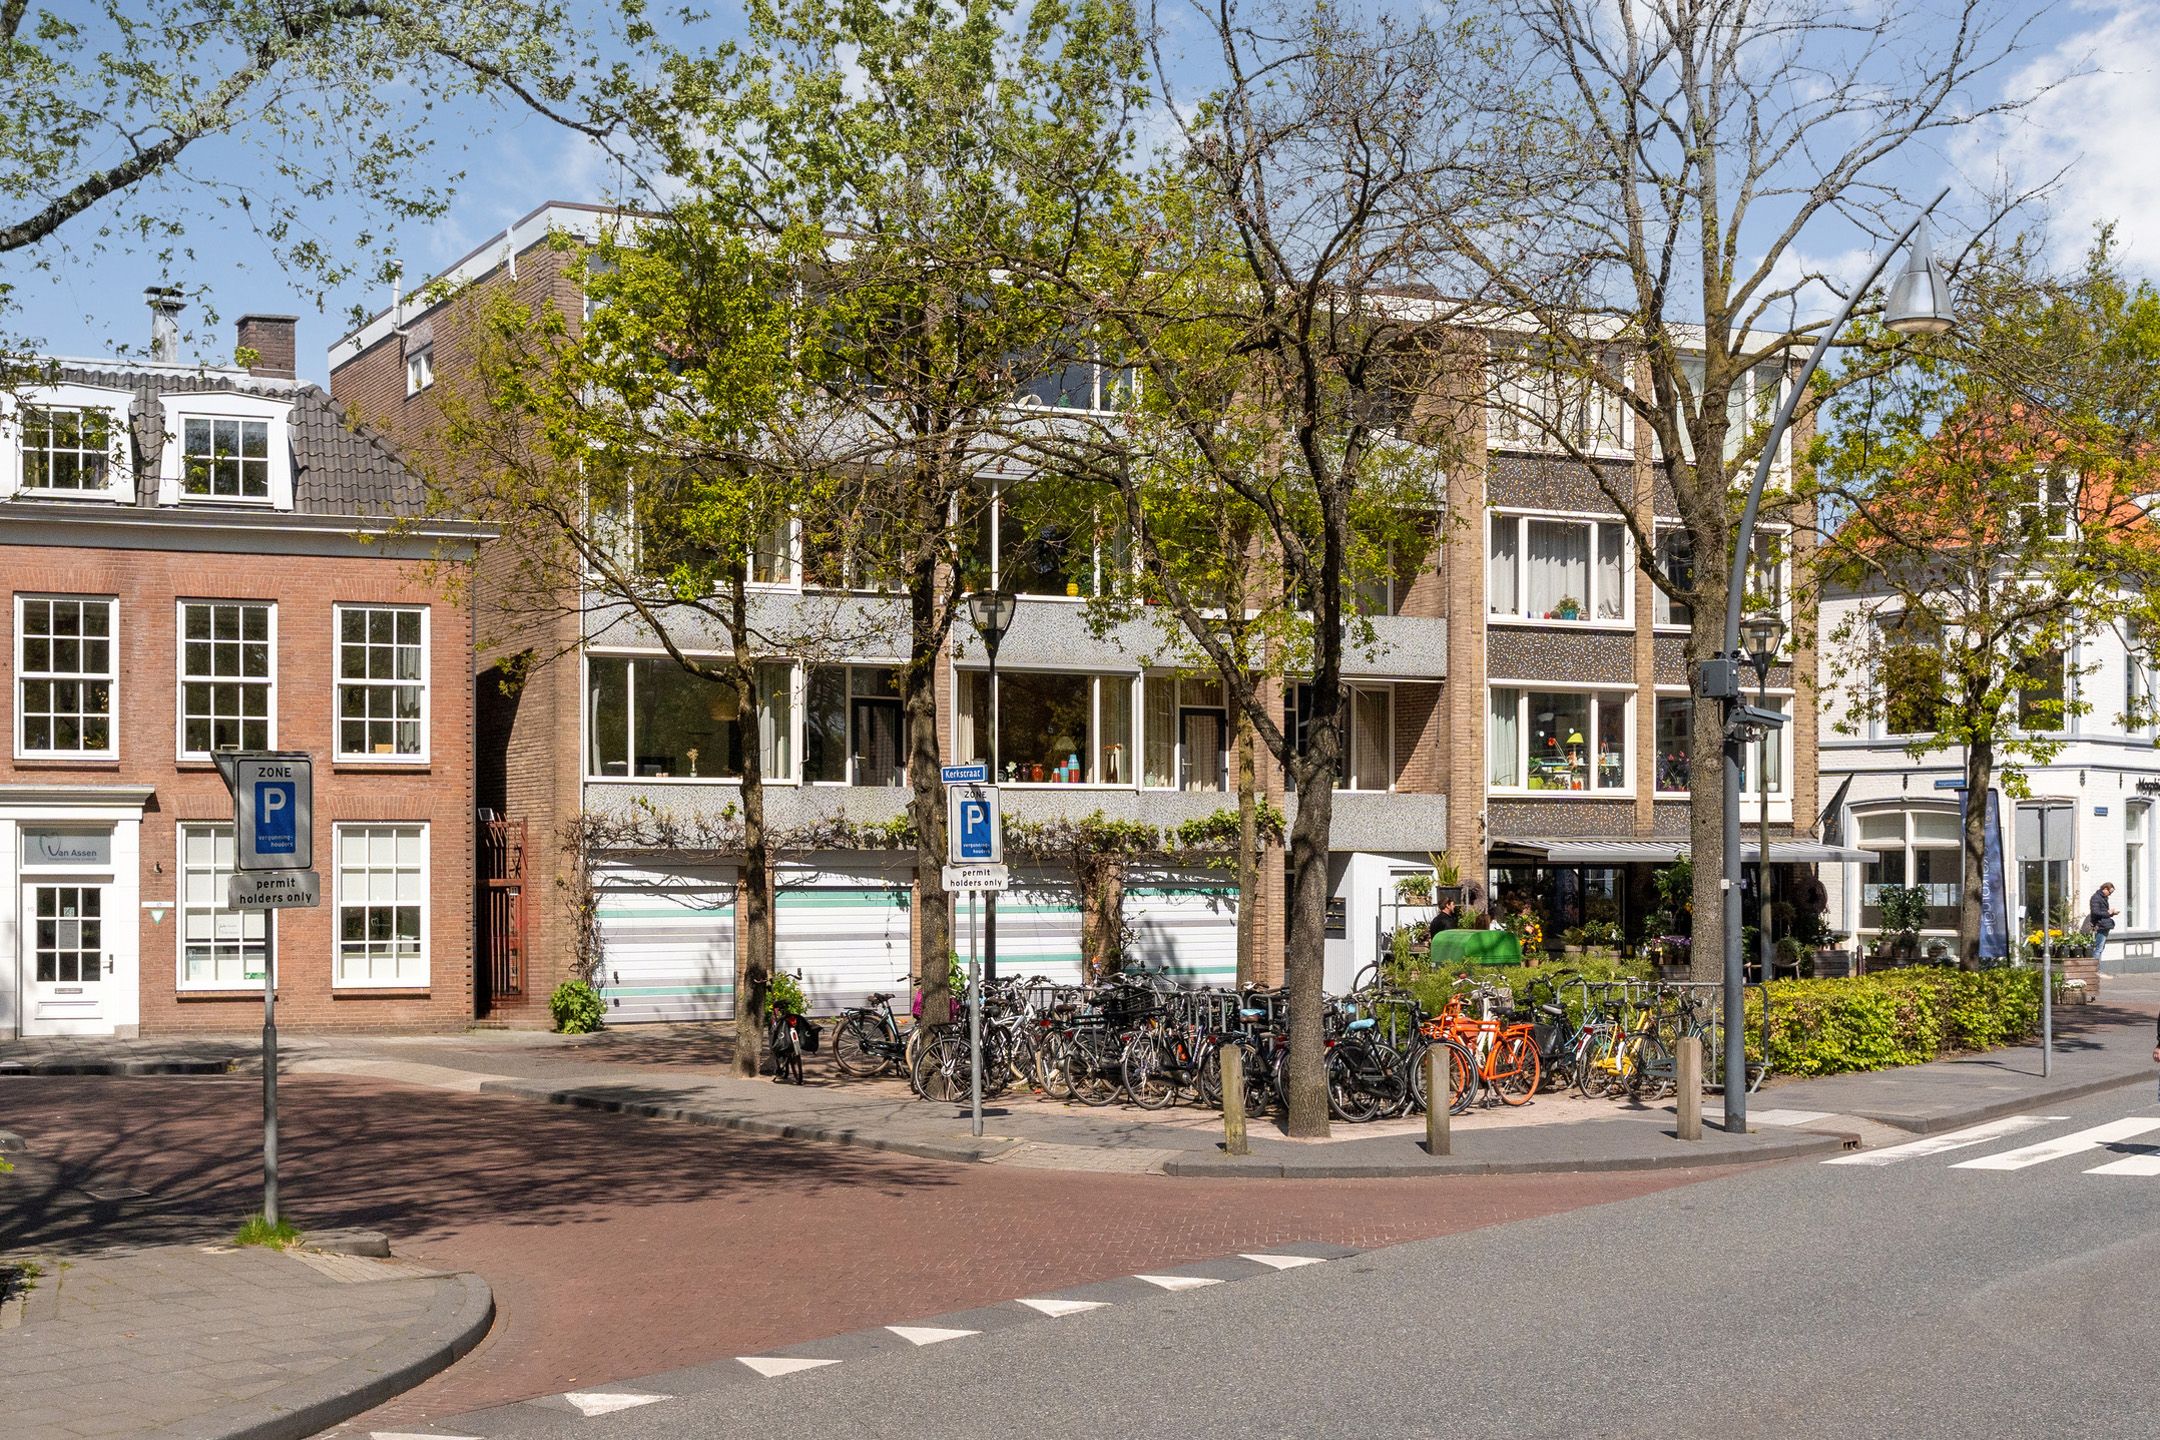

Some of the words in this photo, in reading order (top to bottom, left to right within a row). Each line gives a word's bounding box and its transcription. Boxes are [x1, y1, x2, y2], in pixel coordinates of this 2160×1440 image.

[258, 767, 292, 778] ZONE
[945, 769, 981, 779] Kerkstraat
[964, 791, 987, 799] ZONE
[264, 787, 287, 824] P
[967, 805, 985, 834] P
[48, 845, 68, 857] Van
[71, 849, 97, 857] Assen
[962, 869, 991, 878] permit
[256, 878, 296, 891] permit
[984, 879, 1003, 888] only
[240, 894, 284, 904] holders
[287, 892, 312, 904] only
